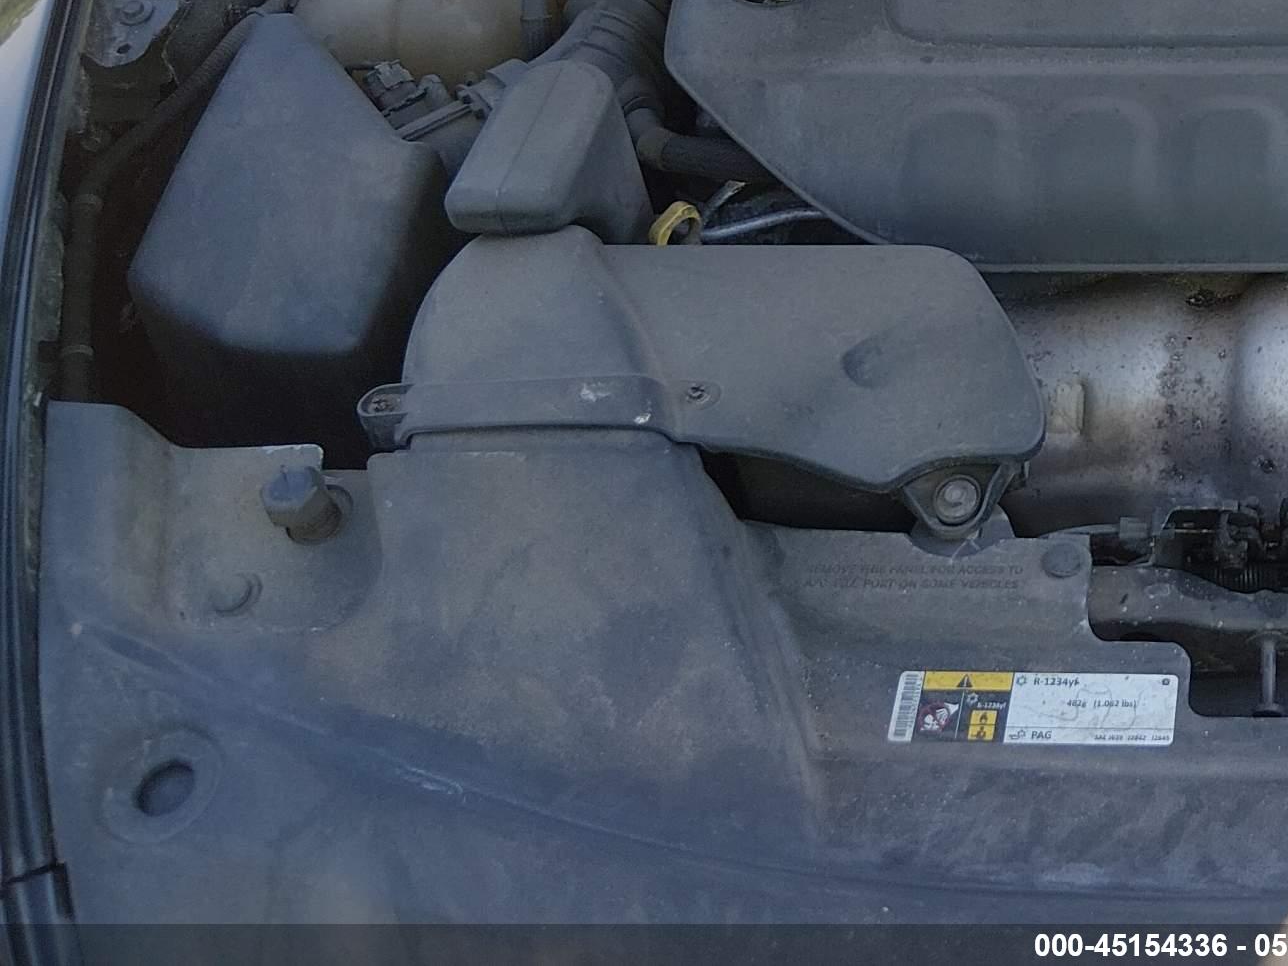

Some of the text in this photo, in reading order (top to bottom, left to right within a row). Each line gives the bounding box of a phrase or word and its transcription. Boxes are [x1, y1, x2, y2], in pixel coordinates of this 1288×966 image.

[1008, 564, 1024, 576] TO
[1033, 676, 1080, 688] R-1234yf
[1031, 730, 1053, 740] PAG
